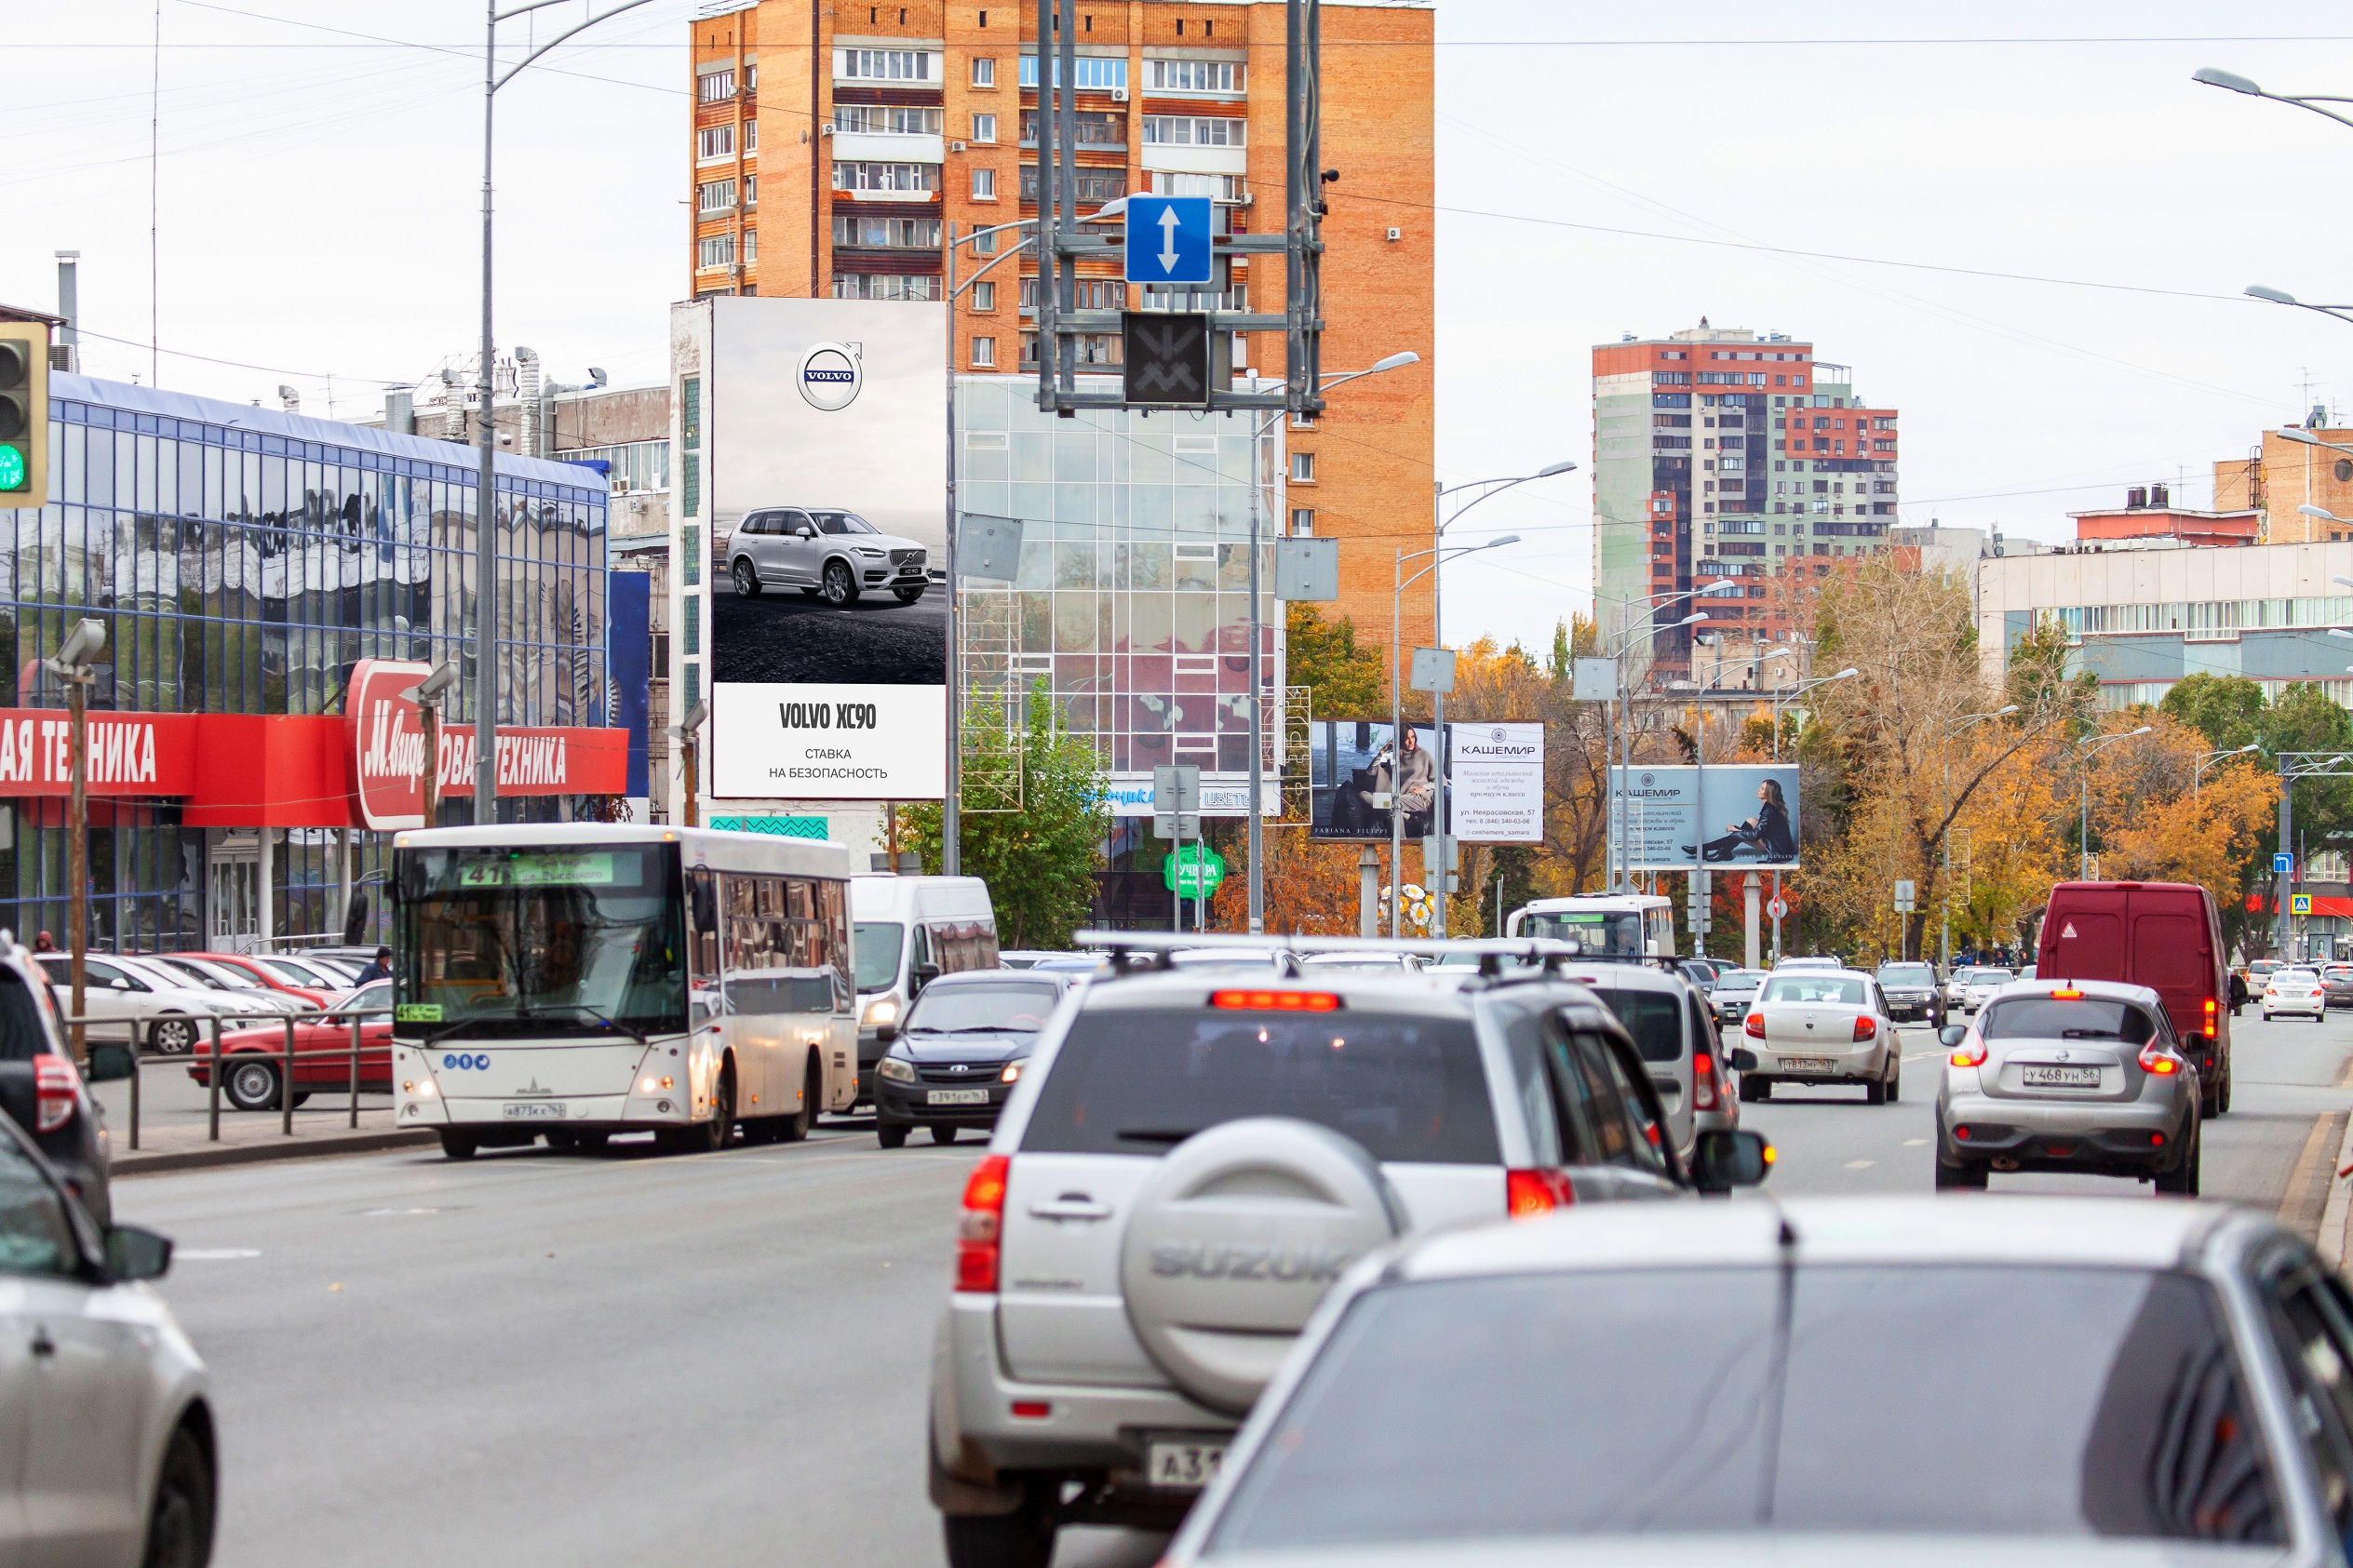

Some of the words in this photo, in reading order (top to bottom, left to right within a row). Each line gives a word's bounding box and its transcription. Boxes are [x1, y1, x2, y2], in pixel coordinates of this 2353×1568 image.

[806, 371, 853, 381] VOLVO
[779, 703, 830, 729] VOLVO
[836, 704, 876, 729] XC90
[42, 720, 156, 783] ТЕНИКА
[805, 748, 852, 759] СТАВКА
[1461, 745, 1536, 755] КАШЕМИР
[769, 768, 786, 778] НА
[789, 768, 888, 779] БЕЗОПАСНОСТЬ
[468, 864, 502, 883] 41
[1173, 864, 1217, 877] УЧВРА
[1150, 1250, 1341, 1281] SUZUK
